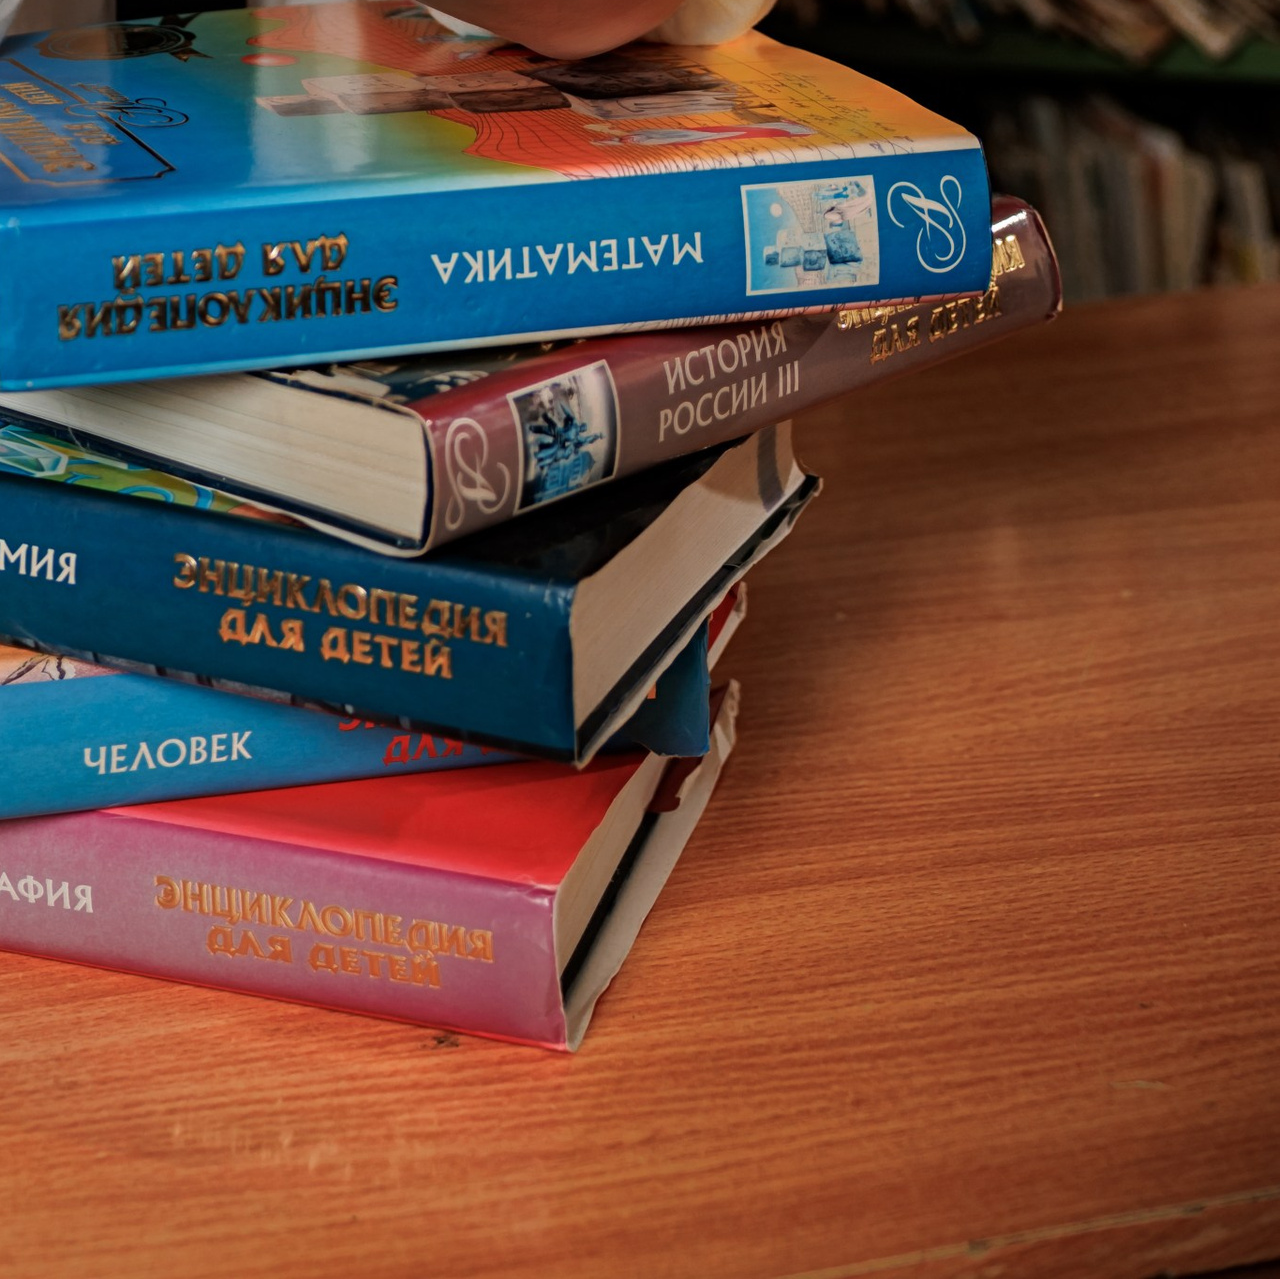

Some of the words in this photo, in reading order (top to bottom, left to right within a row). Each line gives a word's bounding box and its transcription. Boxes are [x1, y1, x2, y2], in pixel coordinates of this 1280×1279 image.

[111, 240, 246, 295] ДЕТЕЙ
[261, 231, 349, 277] ДЛЯ
[430, 231, 705, 285] МАТЕМАТИКА
[57, 274, 399, 341] ЭНЦИКЛОПЕДИЯ
[870, 315, 922, 365] ДЛЯ
[662, 320, 788, 396] ИСТОРИЯ
[658, 371, 768, 444] РОССИИ
[777, 359, 800, 398] III
[173, 552, 509, 648] ЭНЦИКЛОПЕДИЯ
[218, 606, 306, 653] ДЛЯ
[319, 627, 454, 680] ДЕТЕЙ
[83, 730, 253, 776] ЧЕЛОВЕК
[154, 874, 495, 964] ЭНЦИКЛОПЕДИЯ
[206, 923, 294, 964] ДЛЯ
[308, 943, 443, 989] ДЕТЕЙ
